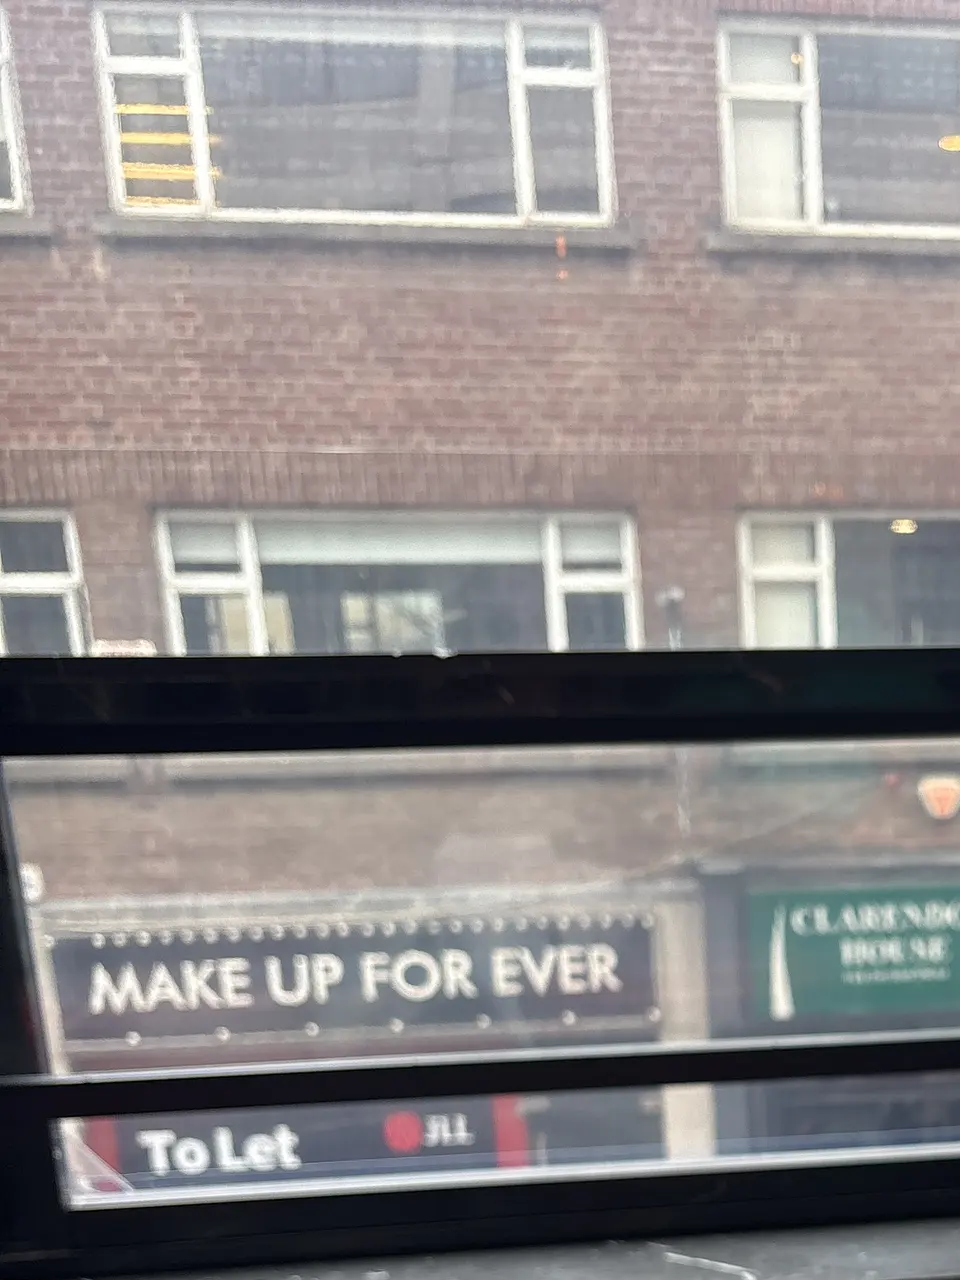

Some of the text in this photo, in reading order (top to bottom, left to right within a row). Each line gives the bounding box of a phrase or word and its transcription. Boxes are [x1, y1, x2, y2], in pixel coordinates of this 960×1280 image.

[840, 935, 951, 967] HOUSE
[89, 943, 623, 1015] MAKE UP FOR EVER
[135, 1123, 302, 1176] To Let
